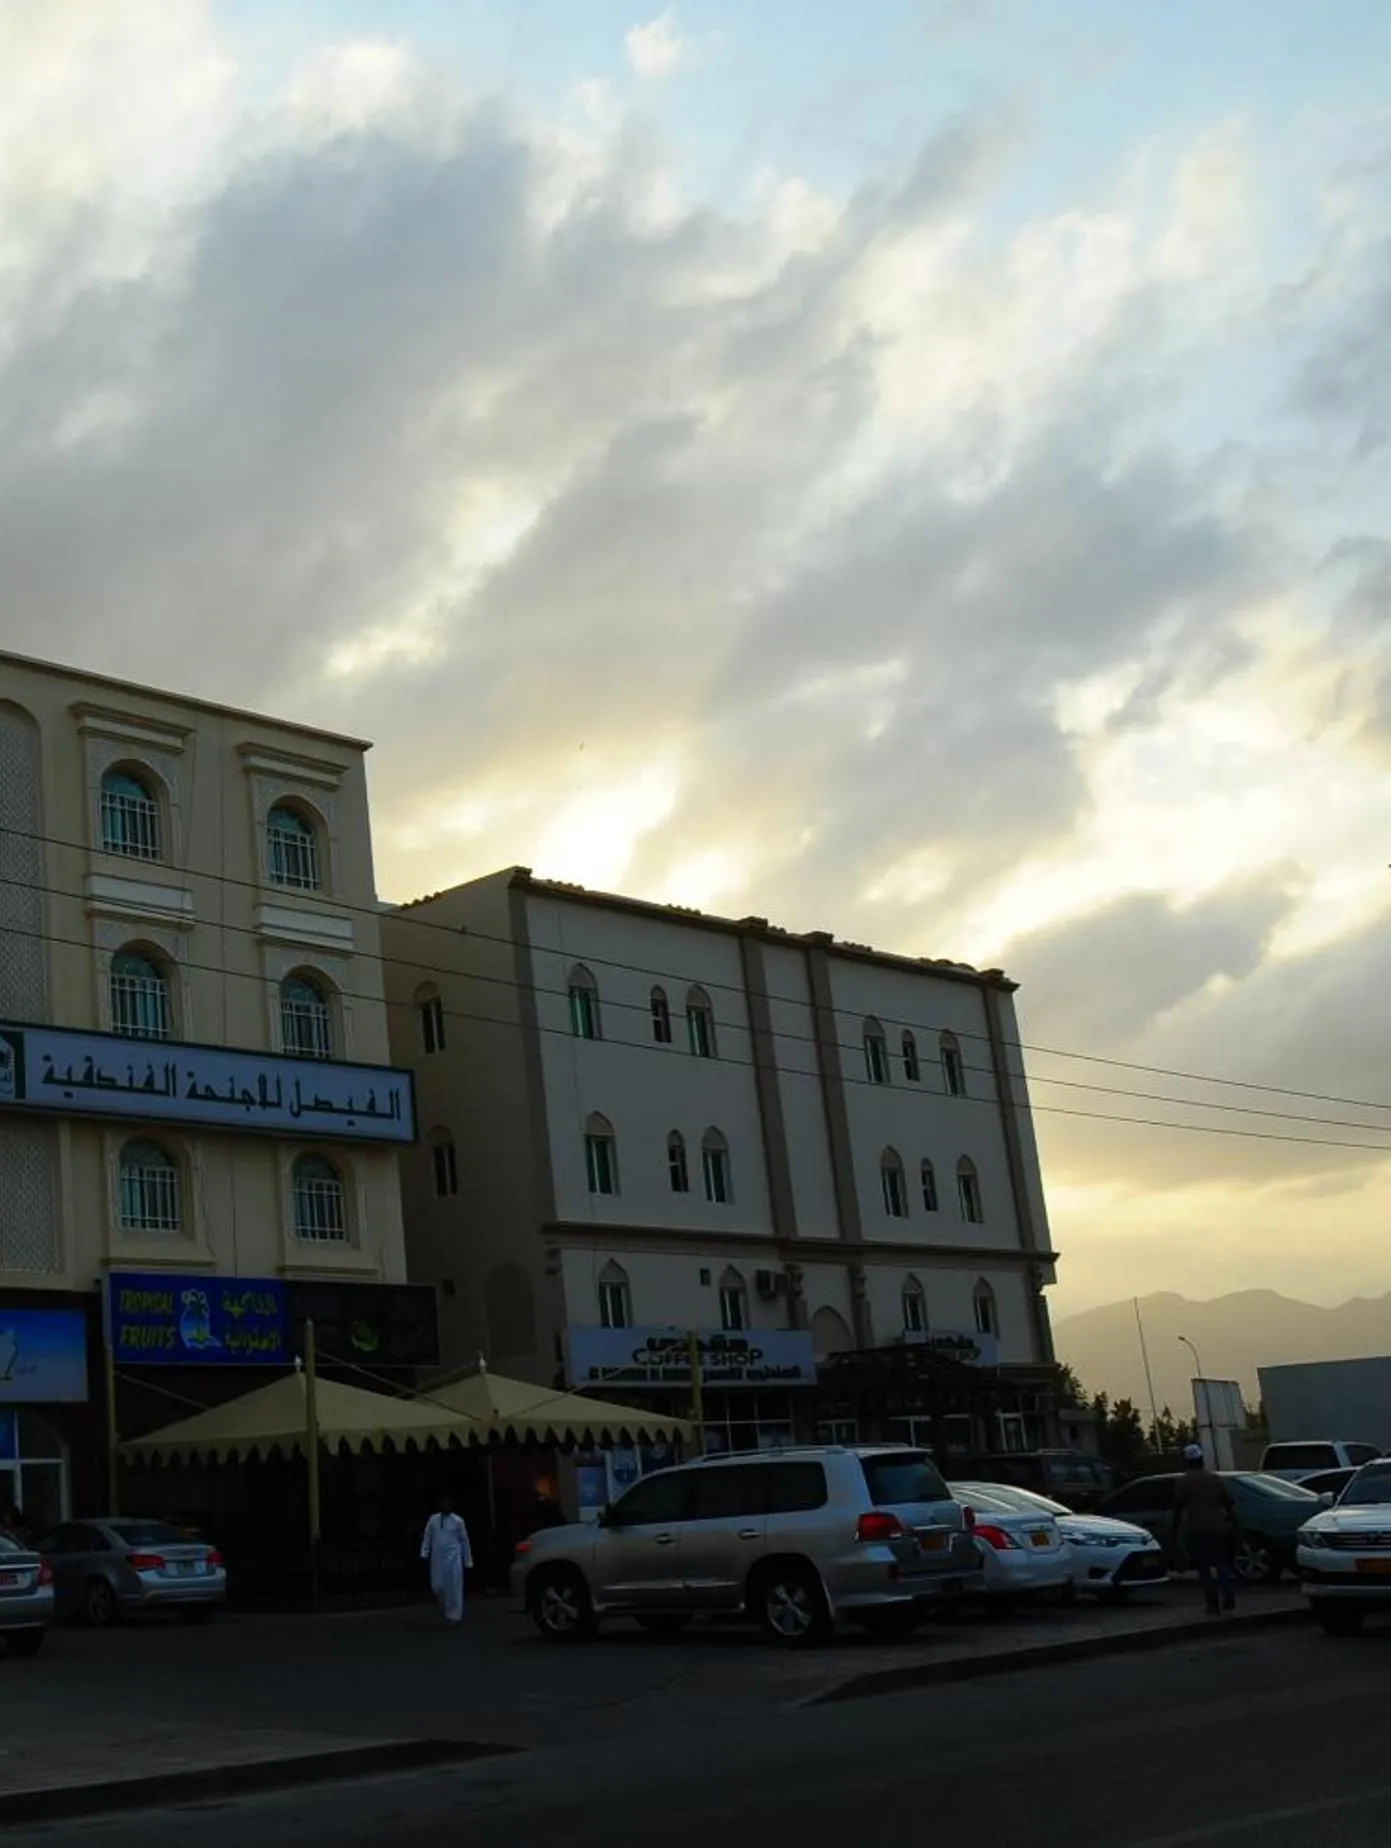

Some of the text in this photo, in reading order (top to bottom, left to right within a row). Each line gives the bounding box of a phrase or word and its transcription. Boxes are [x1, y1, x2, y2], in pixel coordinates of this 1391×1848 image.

[41, 1053, 177, 1100] الفندقية
[289, 1077, 401, 1126] الفيصل
[119, 1325, 177, 1350] FRUITS
[711, 1348, 763, 1366] SHOP
